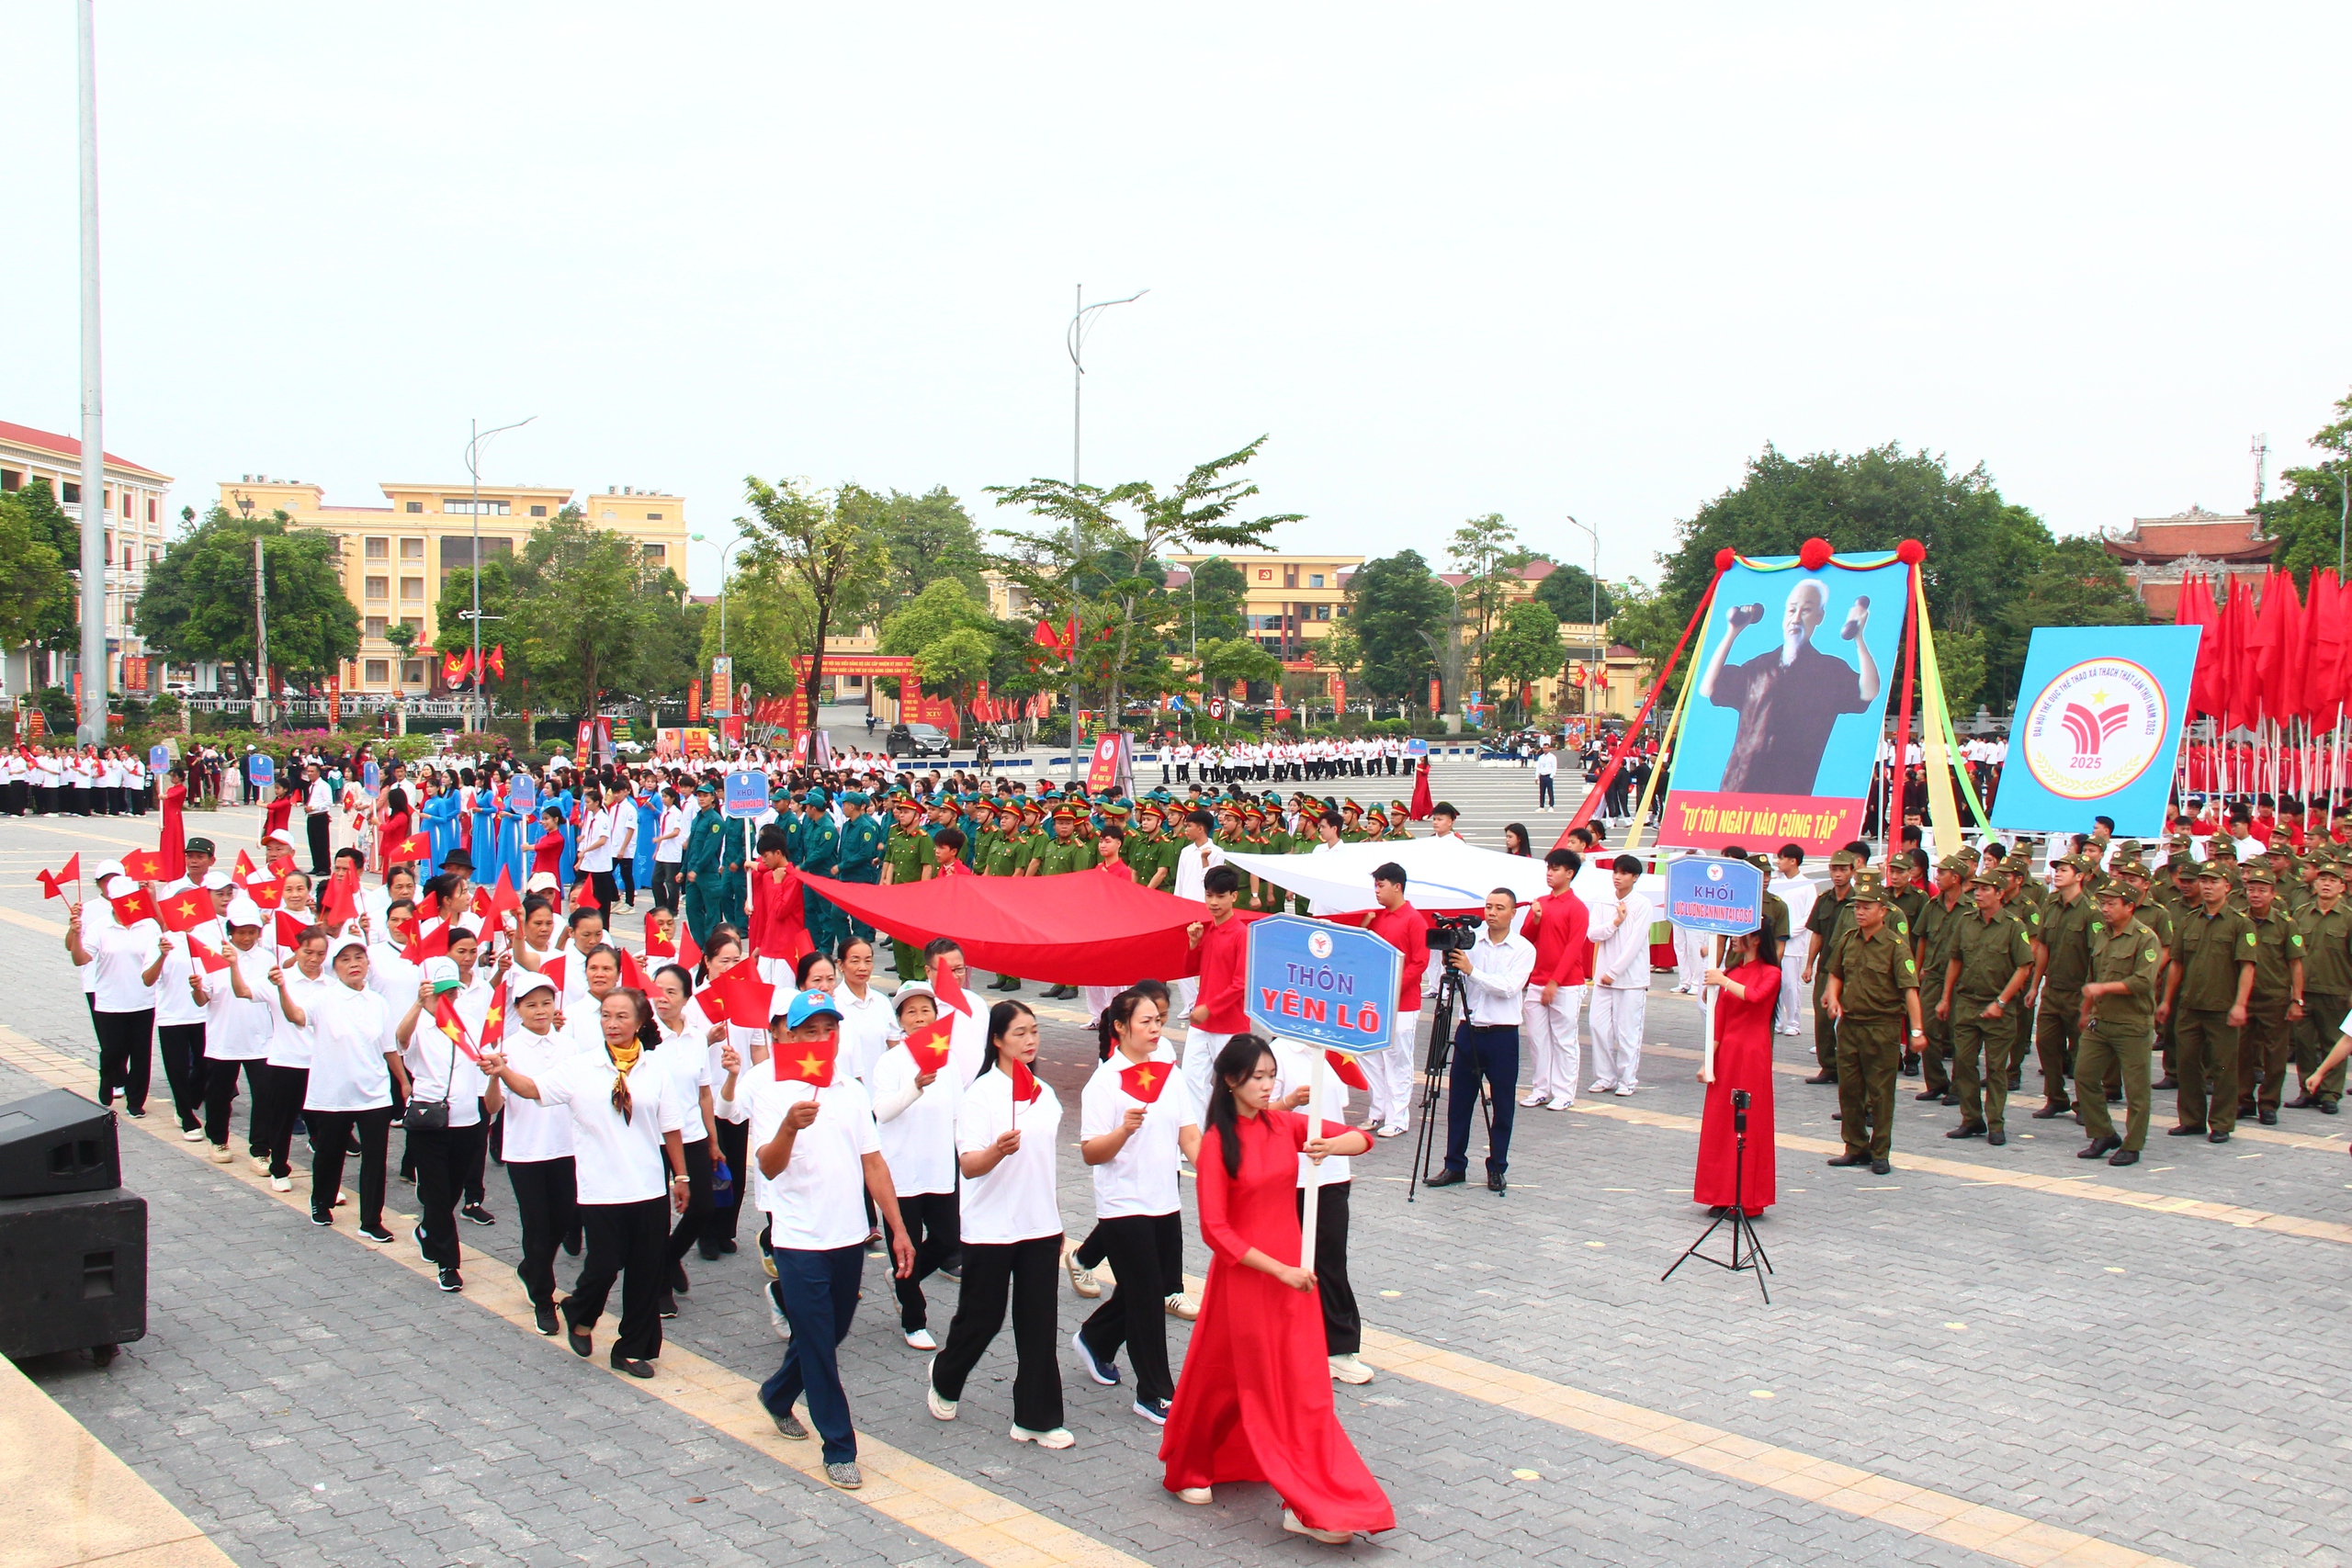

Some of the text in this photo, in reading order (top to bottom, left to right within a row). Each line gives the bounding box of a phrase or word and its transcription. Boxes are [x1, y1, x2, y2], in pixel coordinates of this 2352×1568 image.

[2070, 671, 2087, 684] THAO
[2145, 720, 2156, 735] 2025
[2069, 756, 2102, 769] 2025
[1698, 804, 1719, 832] TÔI
[1717, 806, 1752, 835] NGÀY
[1750, 807, 1777, 836] NÀO
[1778, 809, 1812, 838] CŨNG
[1694, 883, 1734, 901] KHỐI
[1705, 905, 1713, 919] AN
[1286, 962, 1354, 996] THÔN
[1261, 987, 1380, 1033] YÊN LỖ
